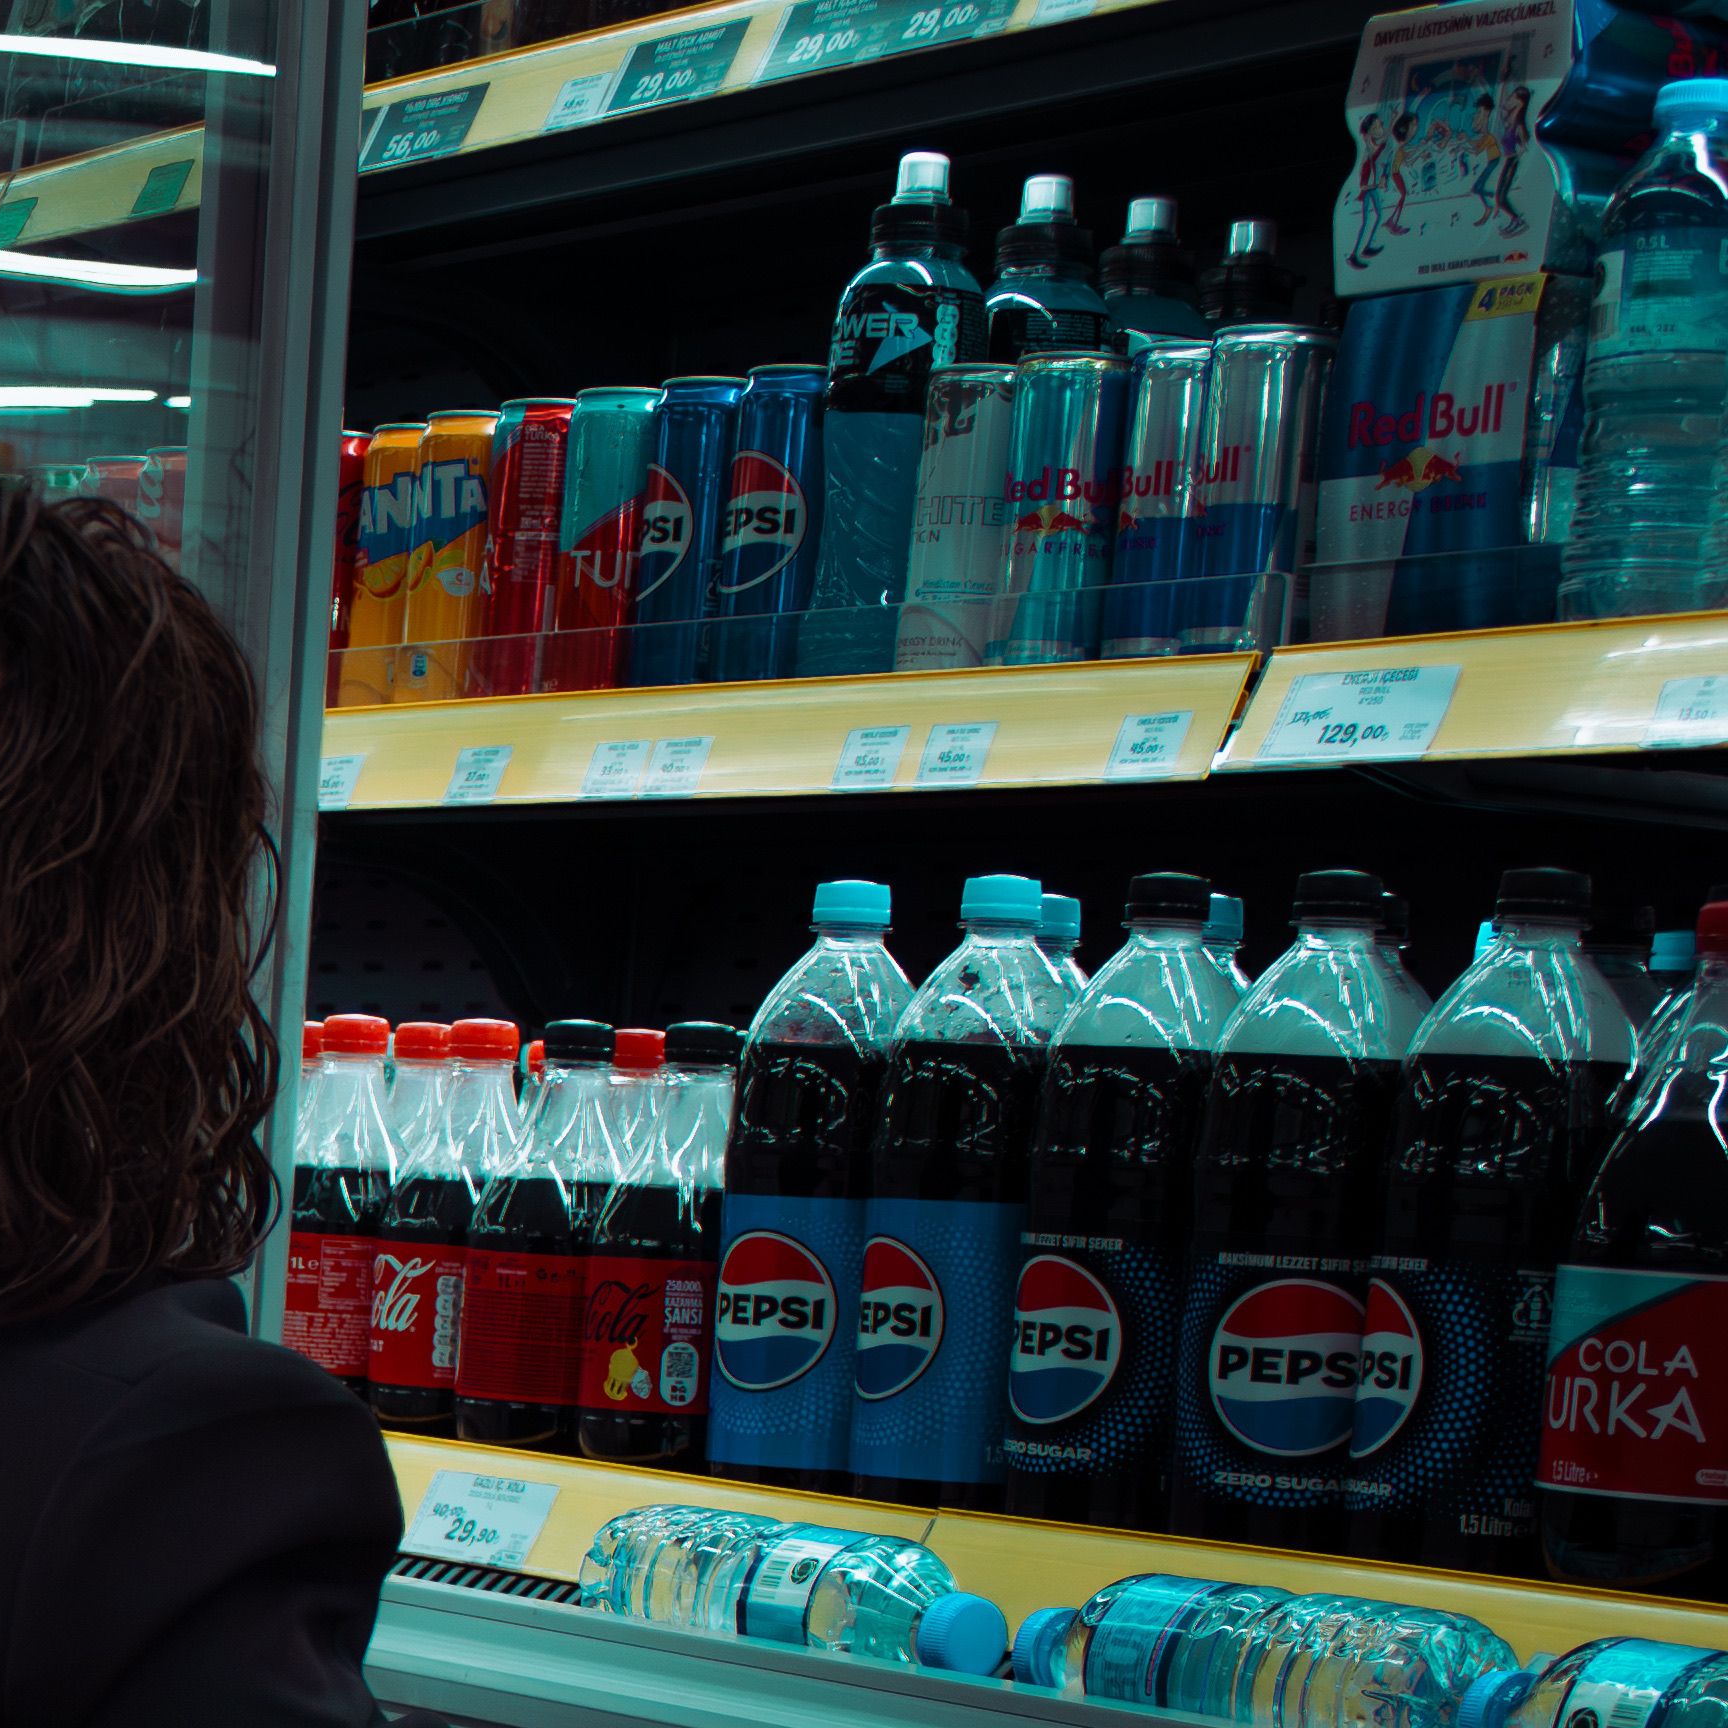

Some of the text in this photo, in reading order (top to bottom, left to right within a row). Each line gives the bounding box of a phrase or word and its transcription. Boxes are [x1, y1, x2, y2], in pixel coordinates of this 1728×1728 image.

[1478, 287, 1495, 311] 4
[1348, 383, 1505, 449] Red Bull
[1350, 491, 1488, 523] ENERGY DRINK
[1276, 1255, 1319, 1271] LEZZET
[664, 1307, 703, 1328] ŞANSI
[718, 1293, 825, 1331] PEPSI
[859, 1301, 932, 1338] EPSI
[1014, 1319, 1110, 1362] EPSI
[1578, 1337, 1699, 1379] COLA
[1545, 1374, 1707, 1444] URKA
[1026, 1441, 1092, 1462] SUGAR
[1214, 1470, 1272, 1489] ZERO
[1564, 1461, 1586, 1483] Litre
[1503, 1498, 1530, 1517] Kola
[1480, 1515, 1512, 1537] Litre
